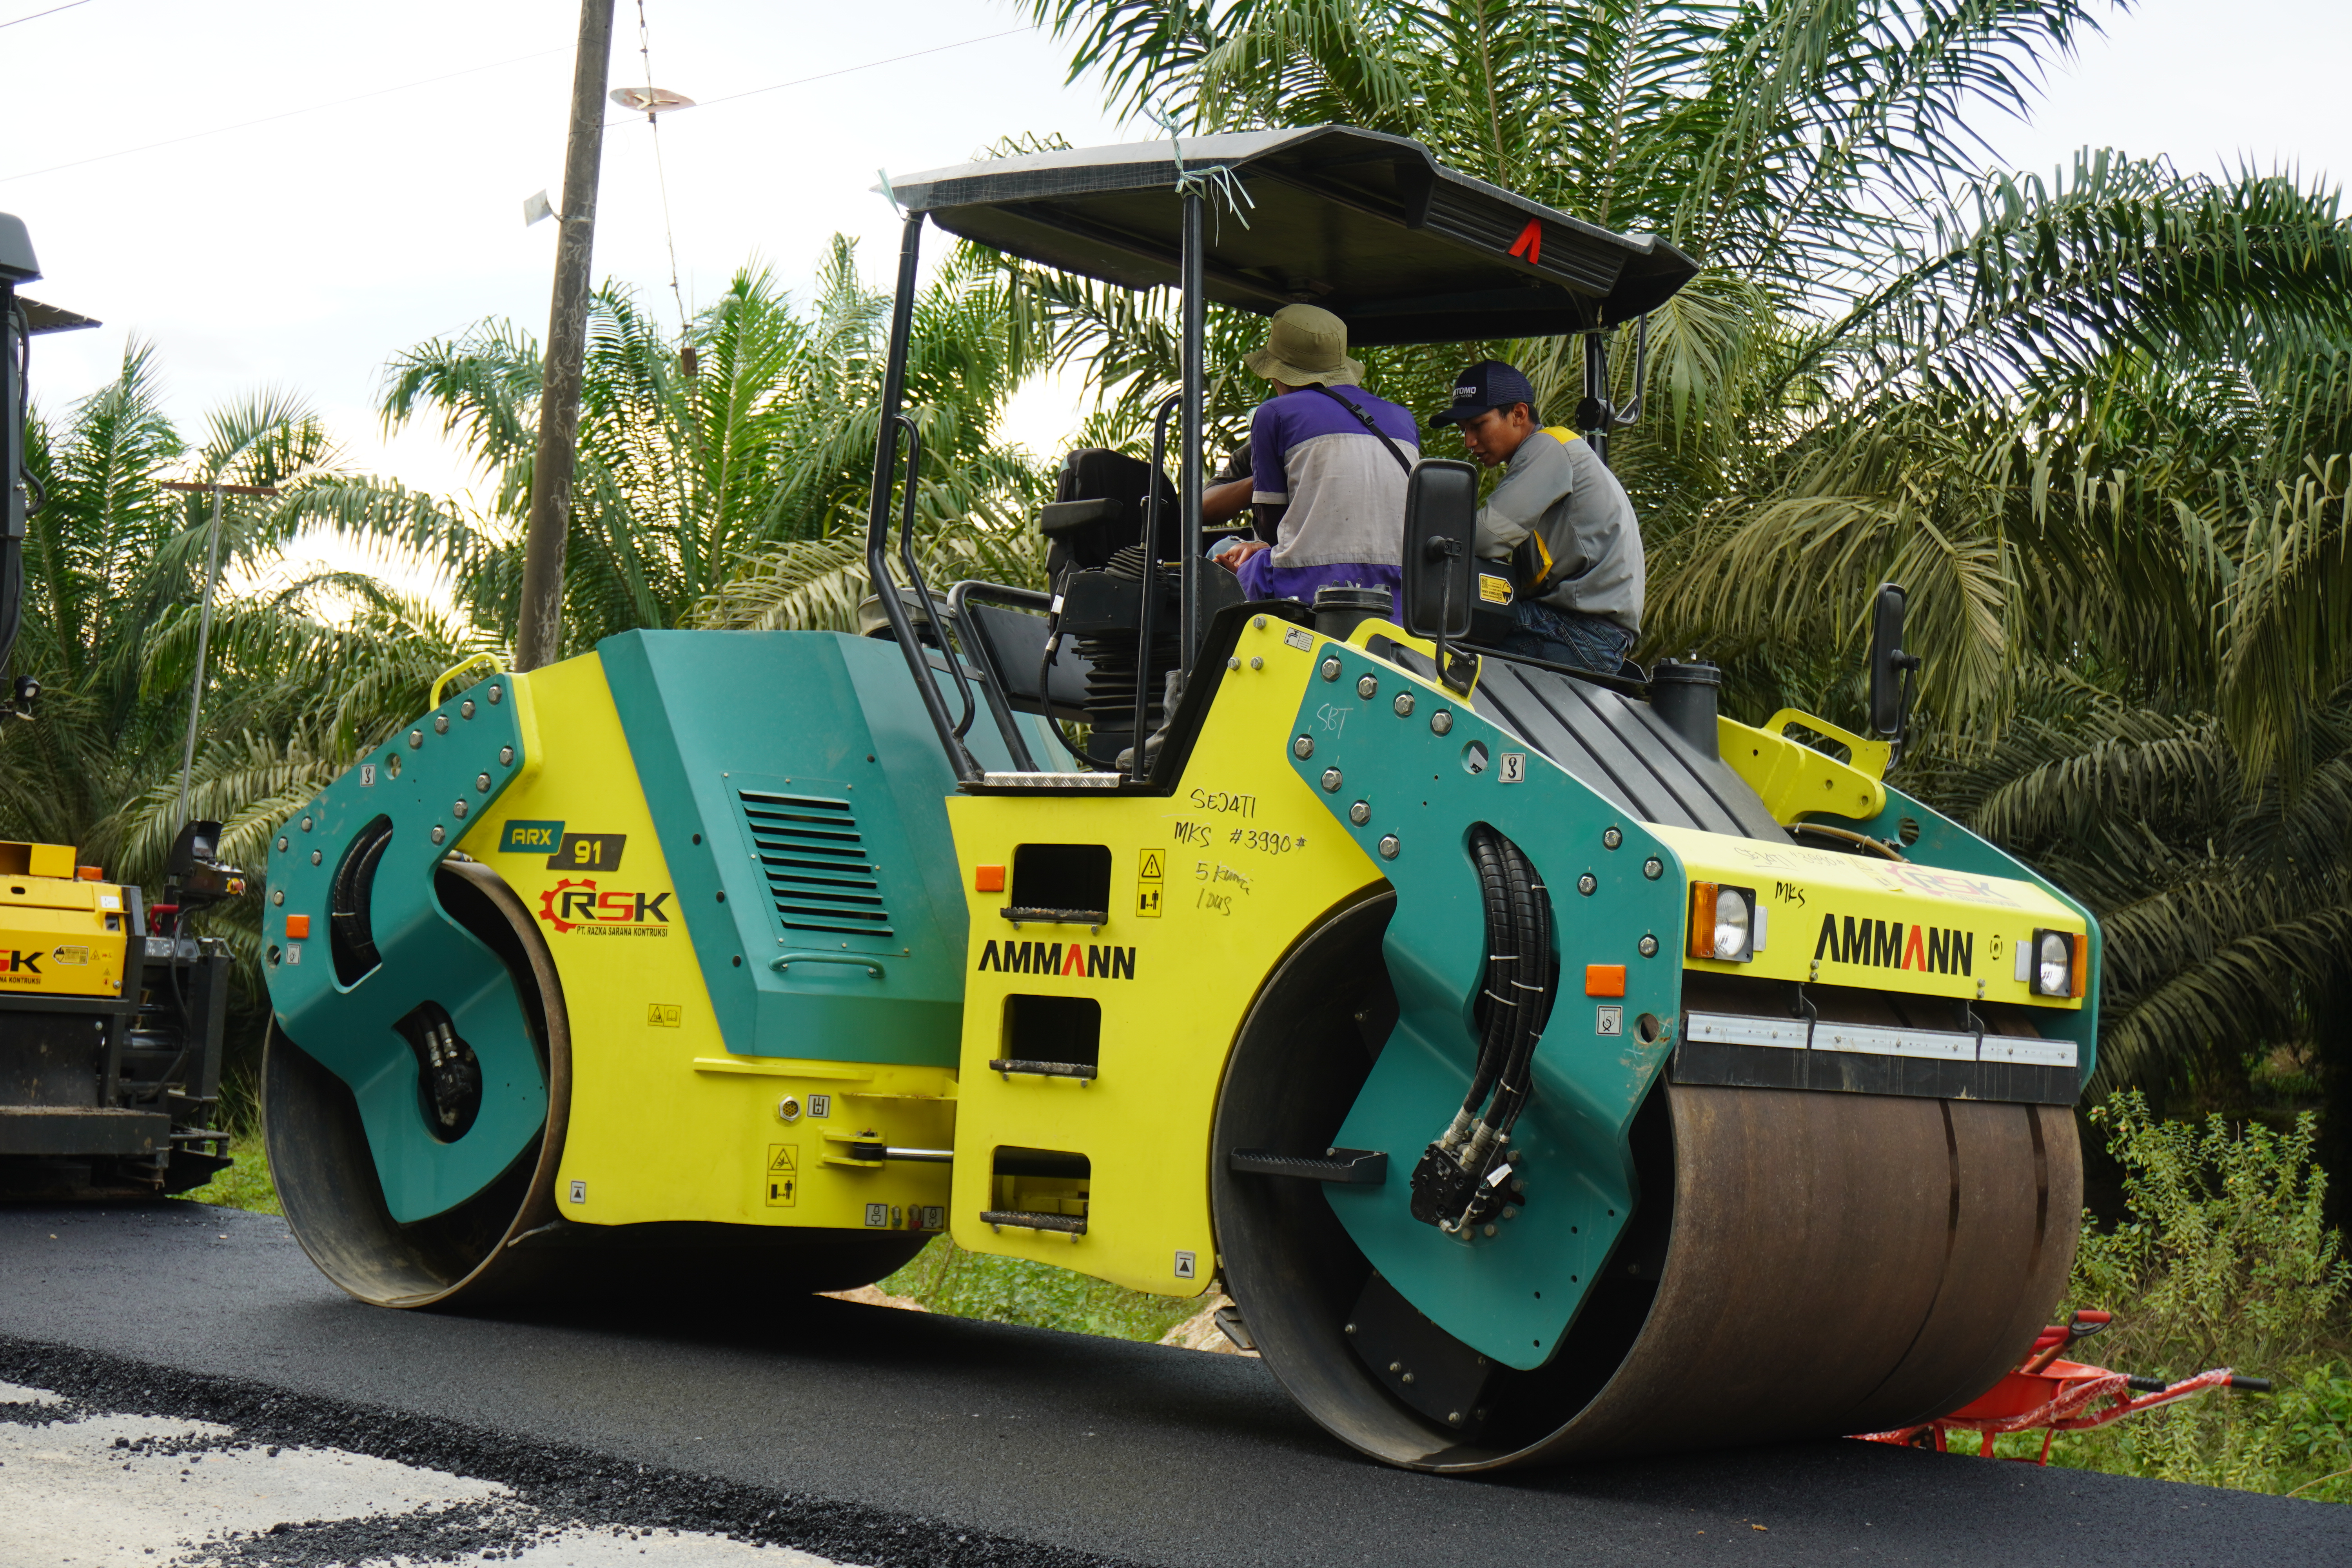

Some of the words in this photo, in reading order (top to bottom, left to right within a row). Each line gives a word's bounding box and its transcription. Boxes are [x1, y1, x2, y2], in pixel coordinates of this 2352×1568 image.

[1190, 788, 1256, 818] SEJATI
[512, 828, 552, 845] ARX
[1174, 821, 1211, 848] MKS
[574, 840, 602, 864] 91
[1196, 862, 1208, 881] 5
[1904, 871, 2011, 900] RSK
[561, 892, 671, 923] RSK
[577, 926, 585, 935] PT.
[588, 926, 606, 936] RAZKA
[608, 927, 632, 936] SARANA
[633, 928, 668, 938] KONTRUKSI
[1814, 913, 1973, 977] AMMANN
[977, 940, 1136, 980] AMMANN
[9, 976, 41, 985] KONTRUKSI
